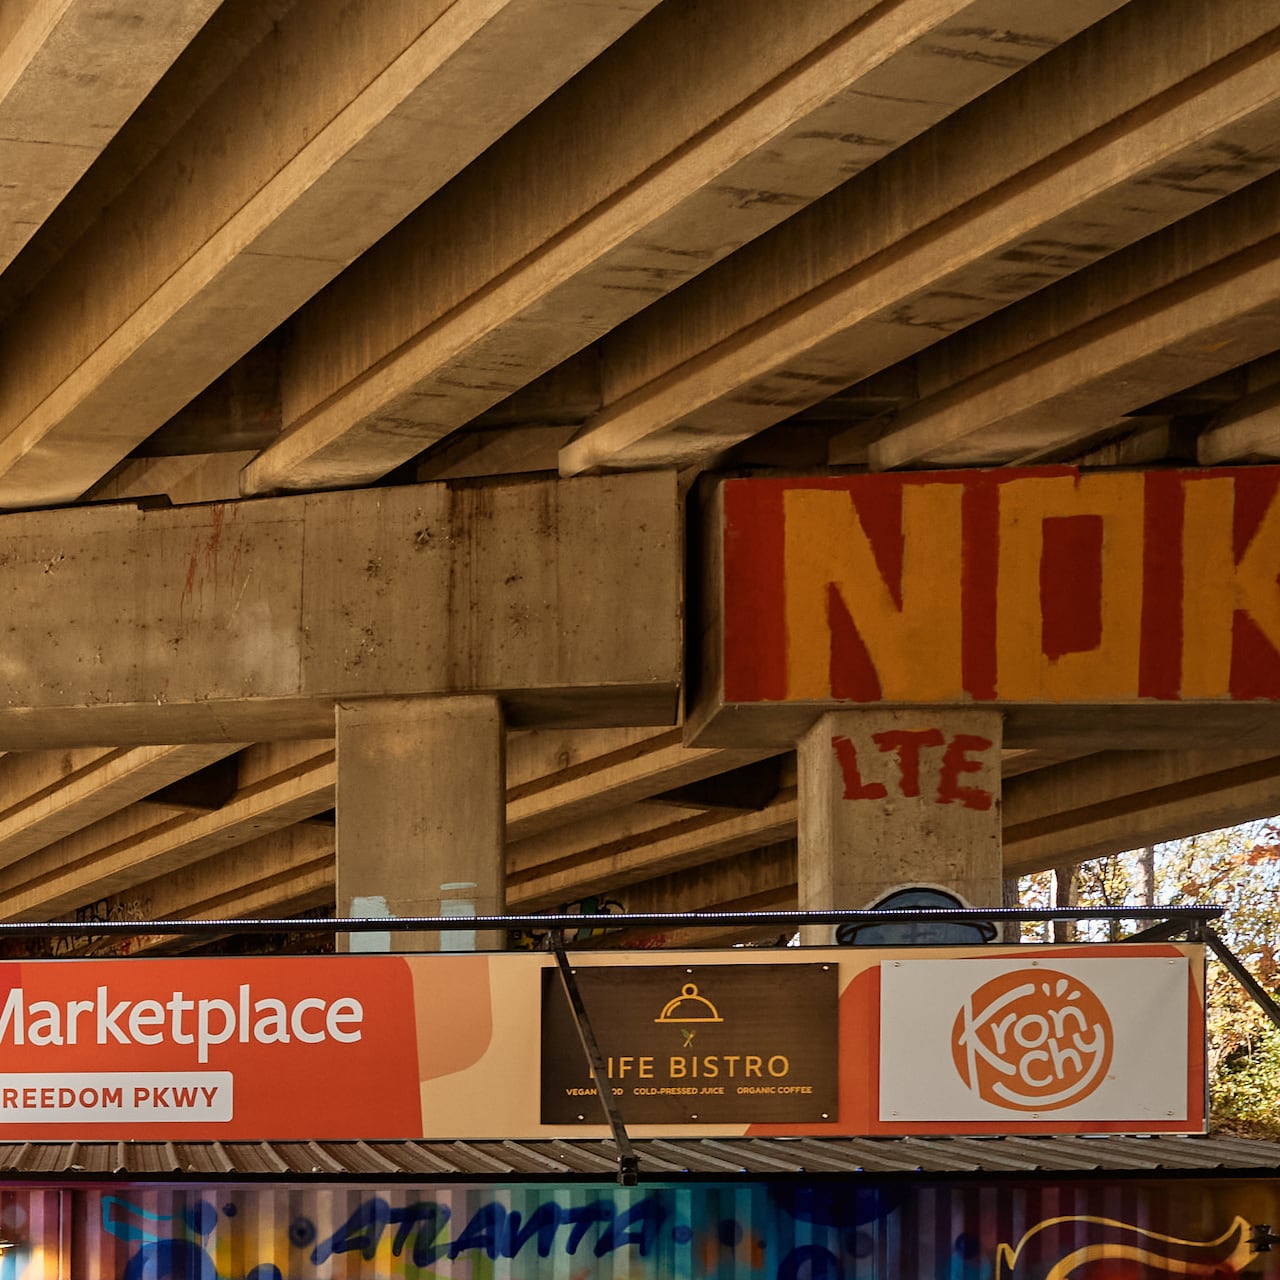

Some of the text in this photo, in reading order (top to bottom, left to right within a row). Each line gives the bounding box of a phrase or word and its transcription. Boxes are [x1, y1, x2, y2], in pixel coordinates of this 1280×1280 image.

[830, 728, 994, 811] LTE
[669, 1055, 789, 1079] BISTRO
[133, 1086, 219, 1109] PKWY
[566, 1088, 597, 1096] VEGAN
[633, 1087, 698, 1095] COLD-PRESSED
[699, 1087, 725, 1095] JUICE
[737, 1086, 813, 1095] ORGANIC COFFEE
[310, 1196, 668, 1266] ATLANTA
